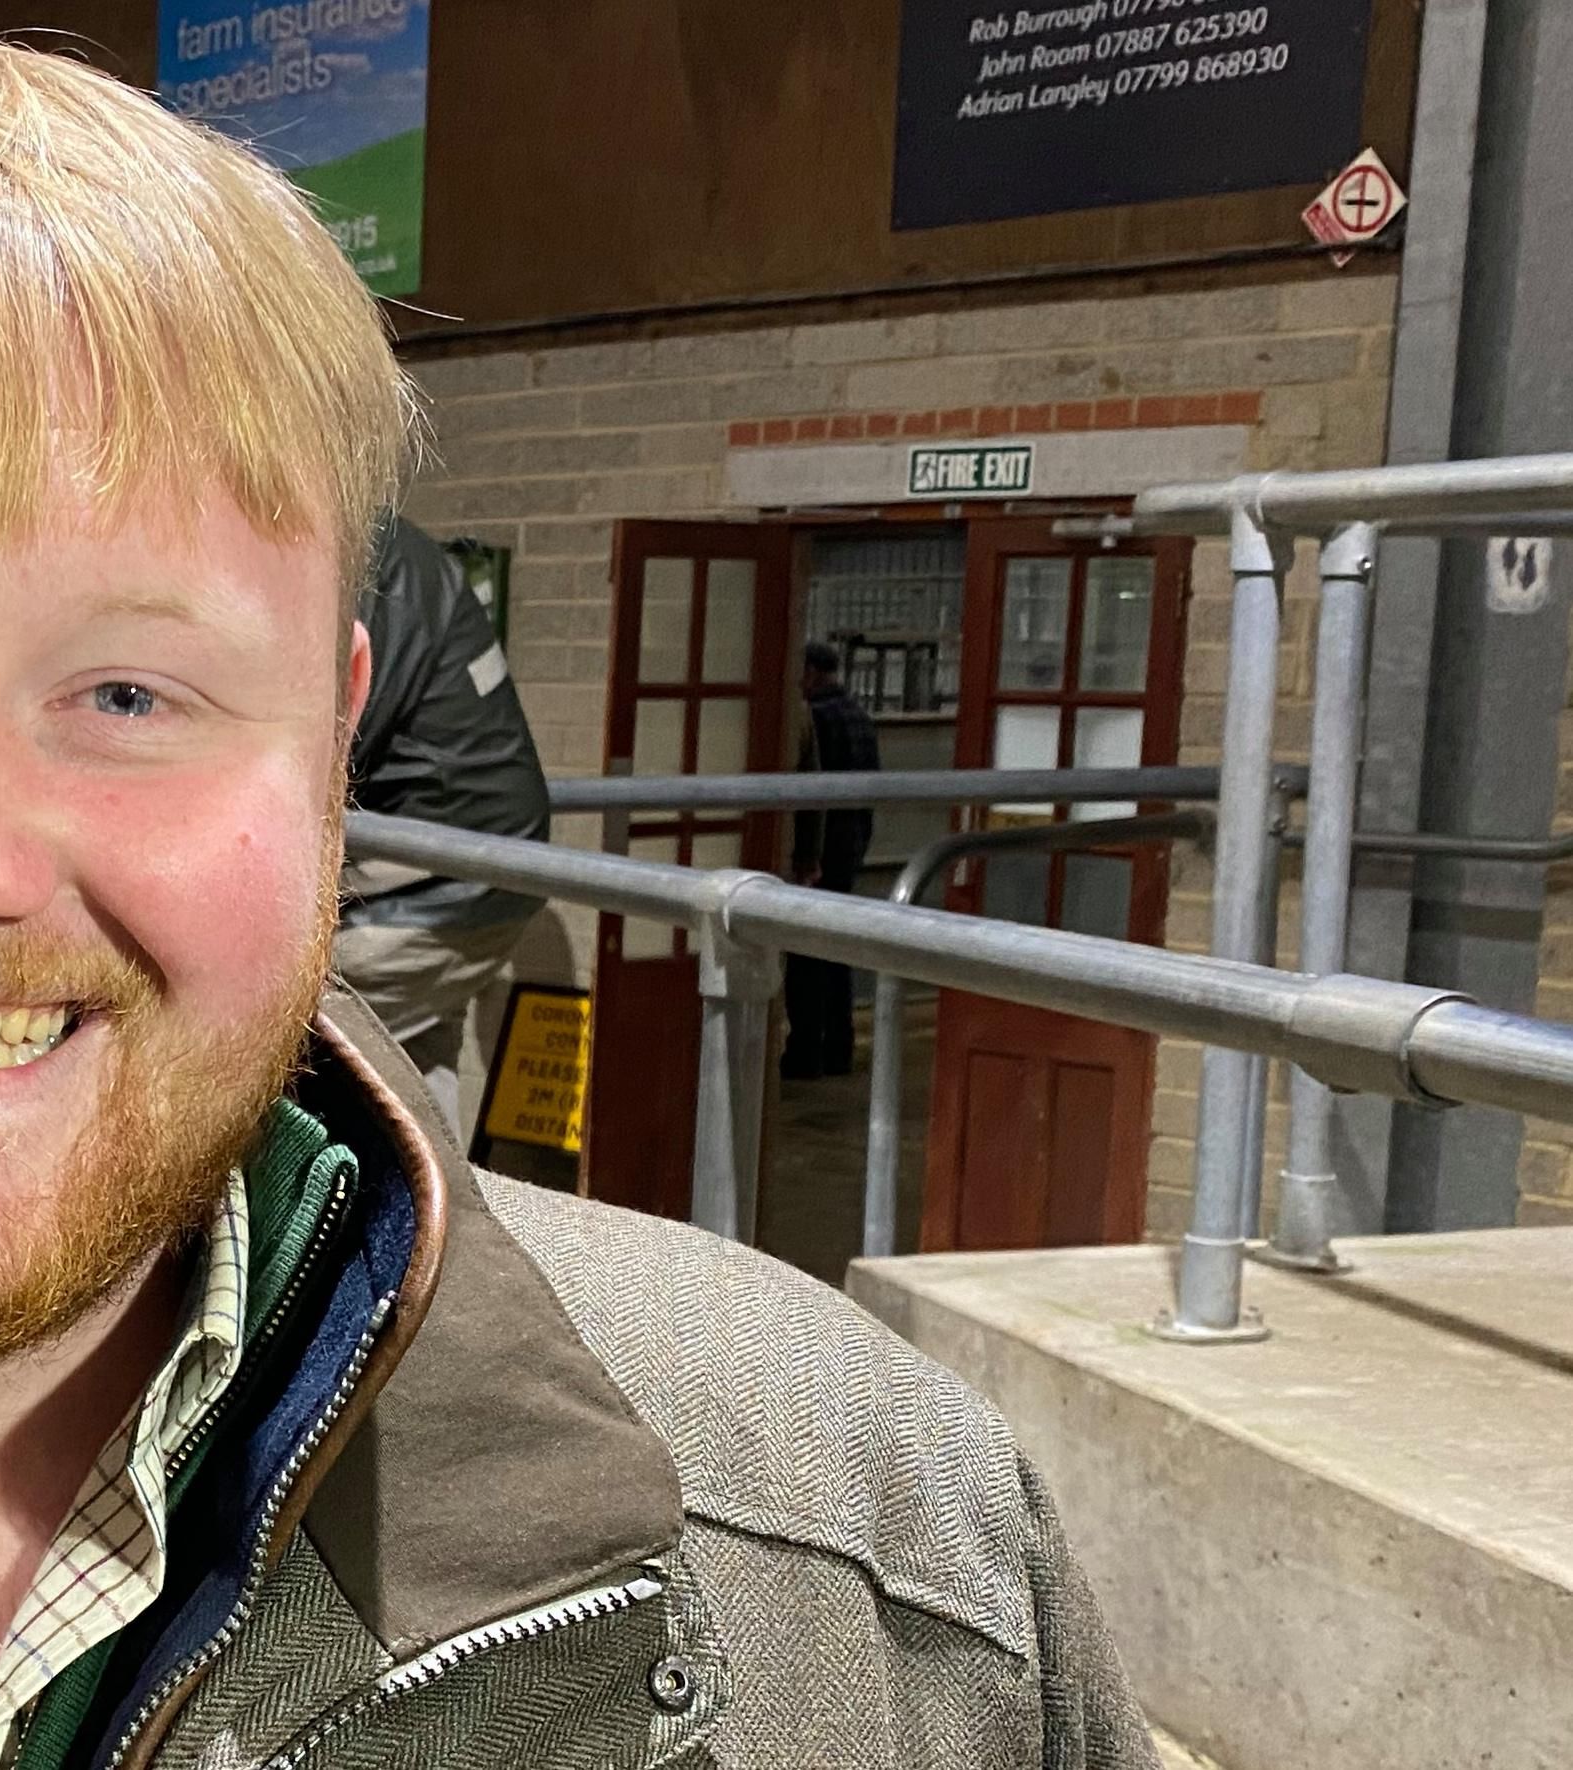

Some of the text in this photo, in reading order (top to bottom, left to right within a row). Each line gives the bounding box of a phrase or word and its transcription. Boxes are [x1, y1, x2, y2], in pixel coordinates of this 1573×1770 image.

[969, 13, 1010, 43] Rob
[1013, 0, 1109, 37] Burrough
[977, 6, 1269, 83] John Room 07887 625390
[176, 42, 333, 114] specialists
[957, 42, 1290, 120] Adrian Langley 07799 868930
[937, 451, 1031, 488] FIRE EXIT
